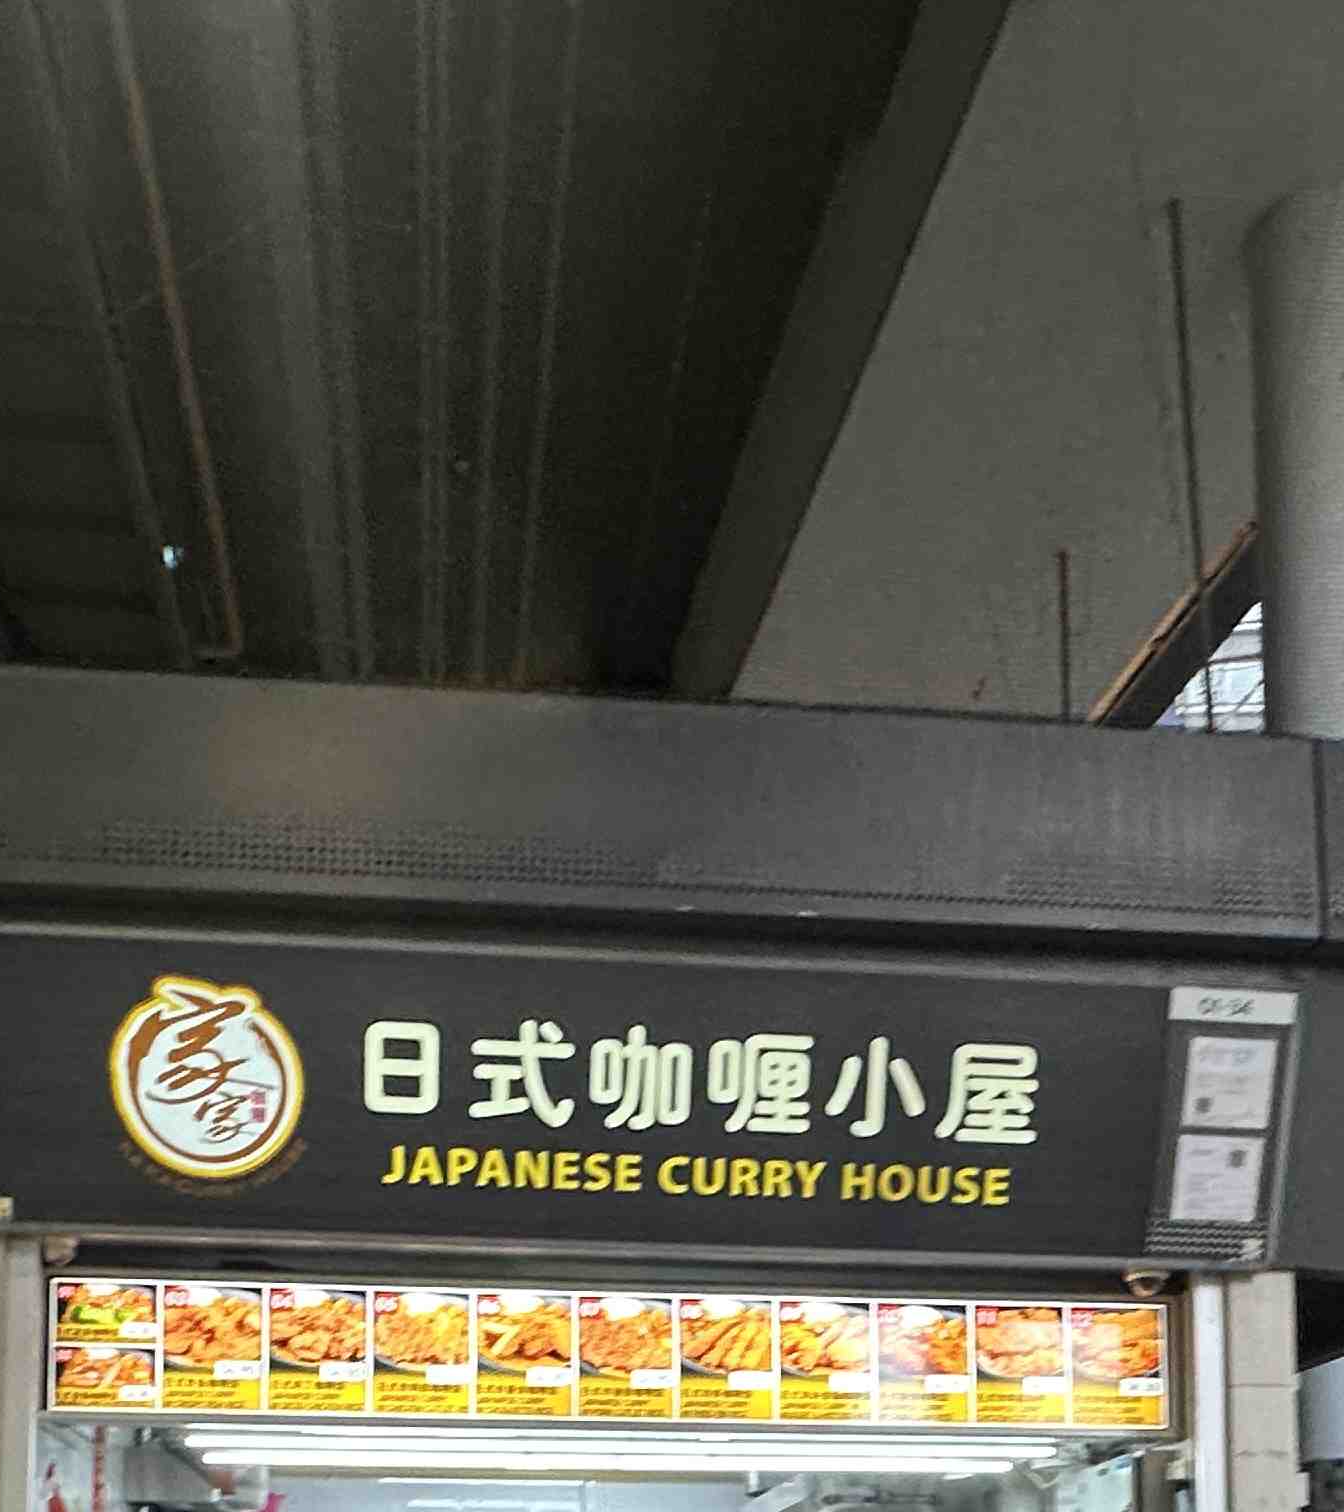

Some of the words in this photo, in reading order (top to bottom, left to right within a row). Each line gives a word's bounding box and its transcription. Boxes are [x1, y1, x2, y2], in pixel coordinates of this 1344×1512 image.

[362, 1018, 1041, 1146] 日式咖喱小屋
[381, 1145, 643, 1192] JAPANESE
[657, 1155, 826, 1199] CURRY
[840, 1163, 1011, 1206] HOUSE
